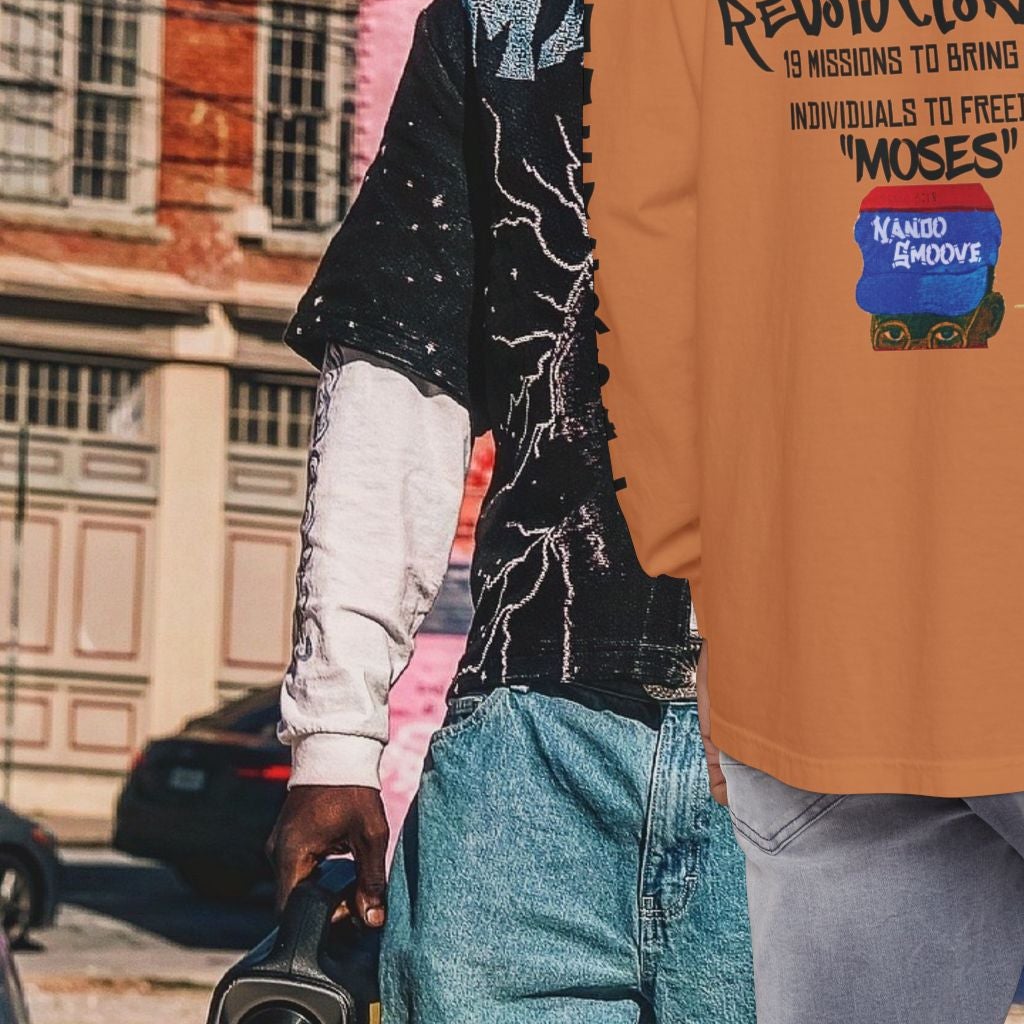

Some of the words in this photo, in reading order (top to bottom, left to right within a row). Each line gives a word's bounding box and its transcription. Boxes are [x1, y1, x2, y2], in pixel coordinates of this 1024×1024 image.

[783, 50, 802, 79] 19
[807, 46, 903, 78] MISSIONS
[909, 44, 940, 74] TO
[946, 40, 1019, 72] BRING
[790, 99, 917, 131] INDIVIDUALS
[924, 96, 954, 126] TO
[871, 215, 947, 244] NANDO
[891, 240, 982, 269] SMOOVE
